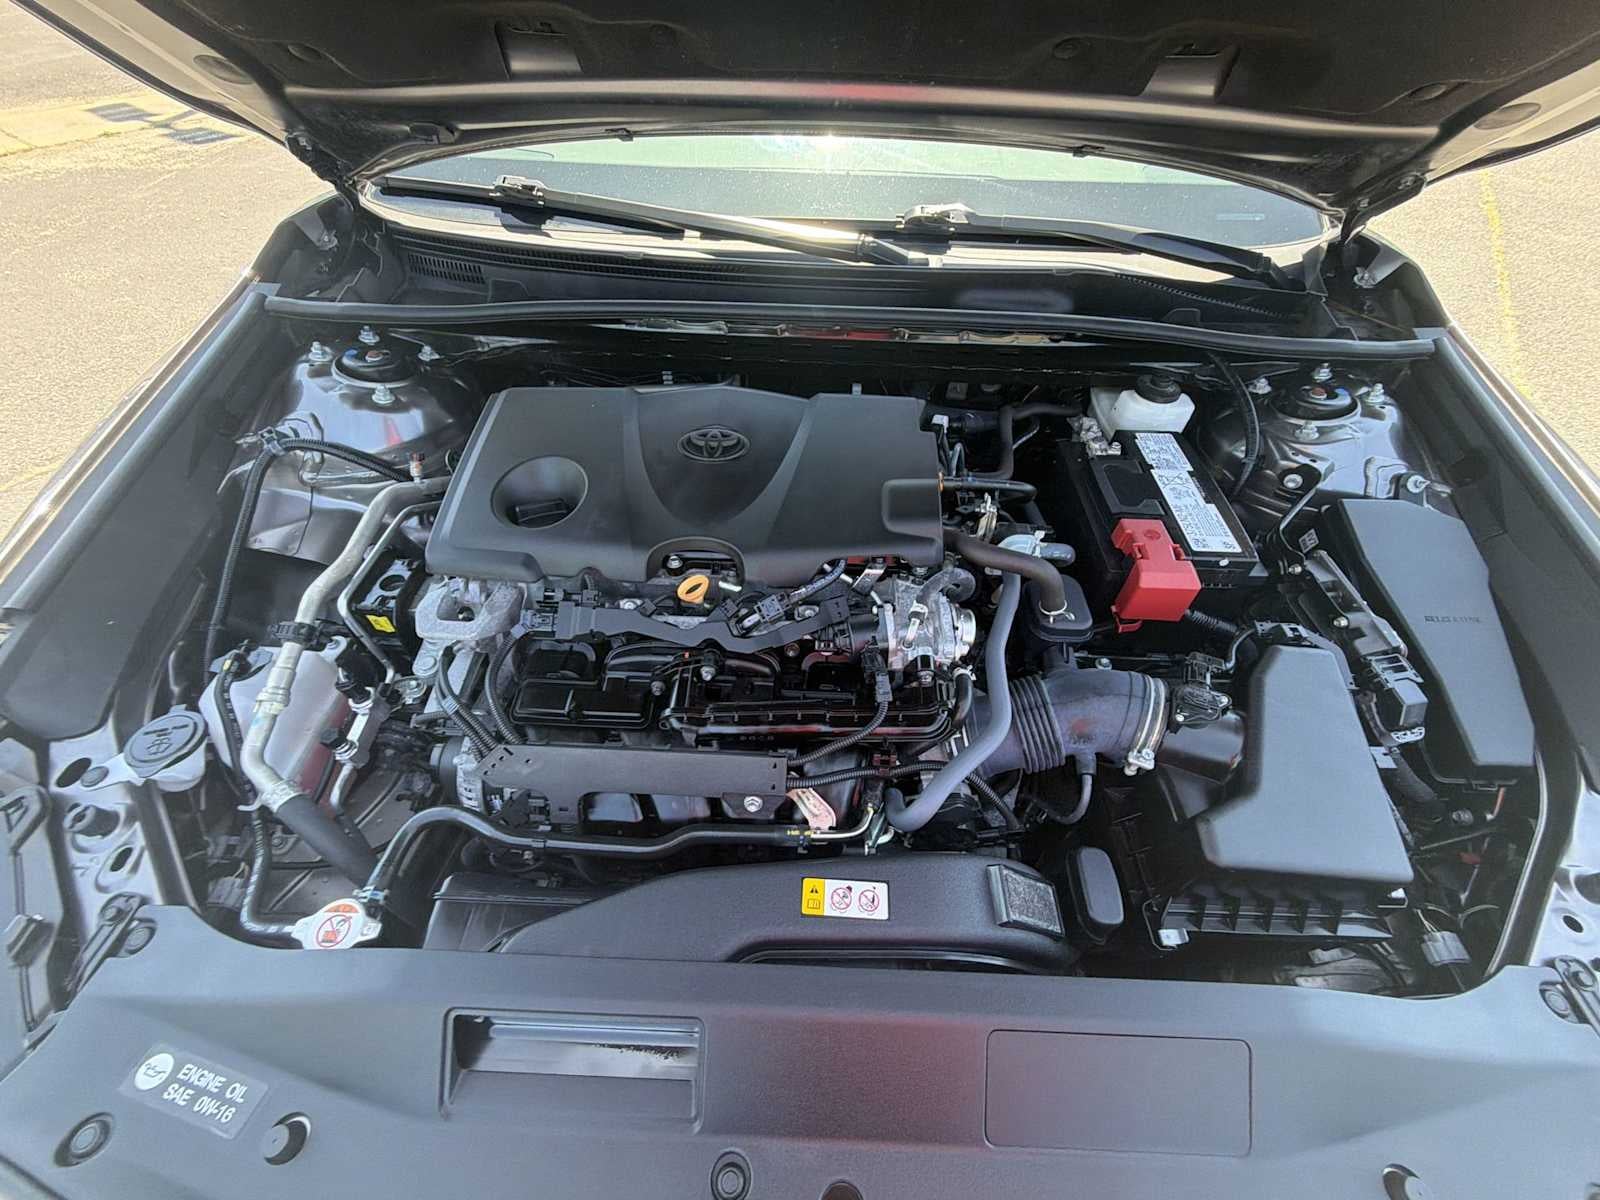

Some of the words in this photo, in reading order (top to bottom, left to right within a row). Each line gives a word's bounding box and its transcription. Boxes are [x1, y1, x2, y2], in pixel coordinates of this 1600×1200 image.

[162, 1083, 195, 1106] SAE
[193, 1096, 236, 1123] 0W-16
[177, 1063, 227, 1093] ENGINE
[225, 1082, 248, 1103] OIL
